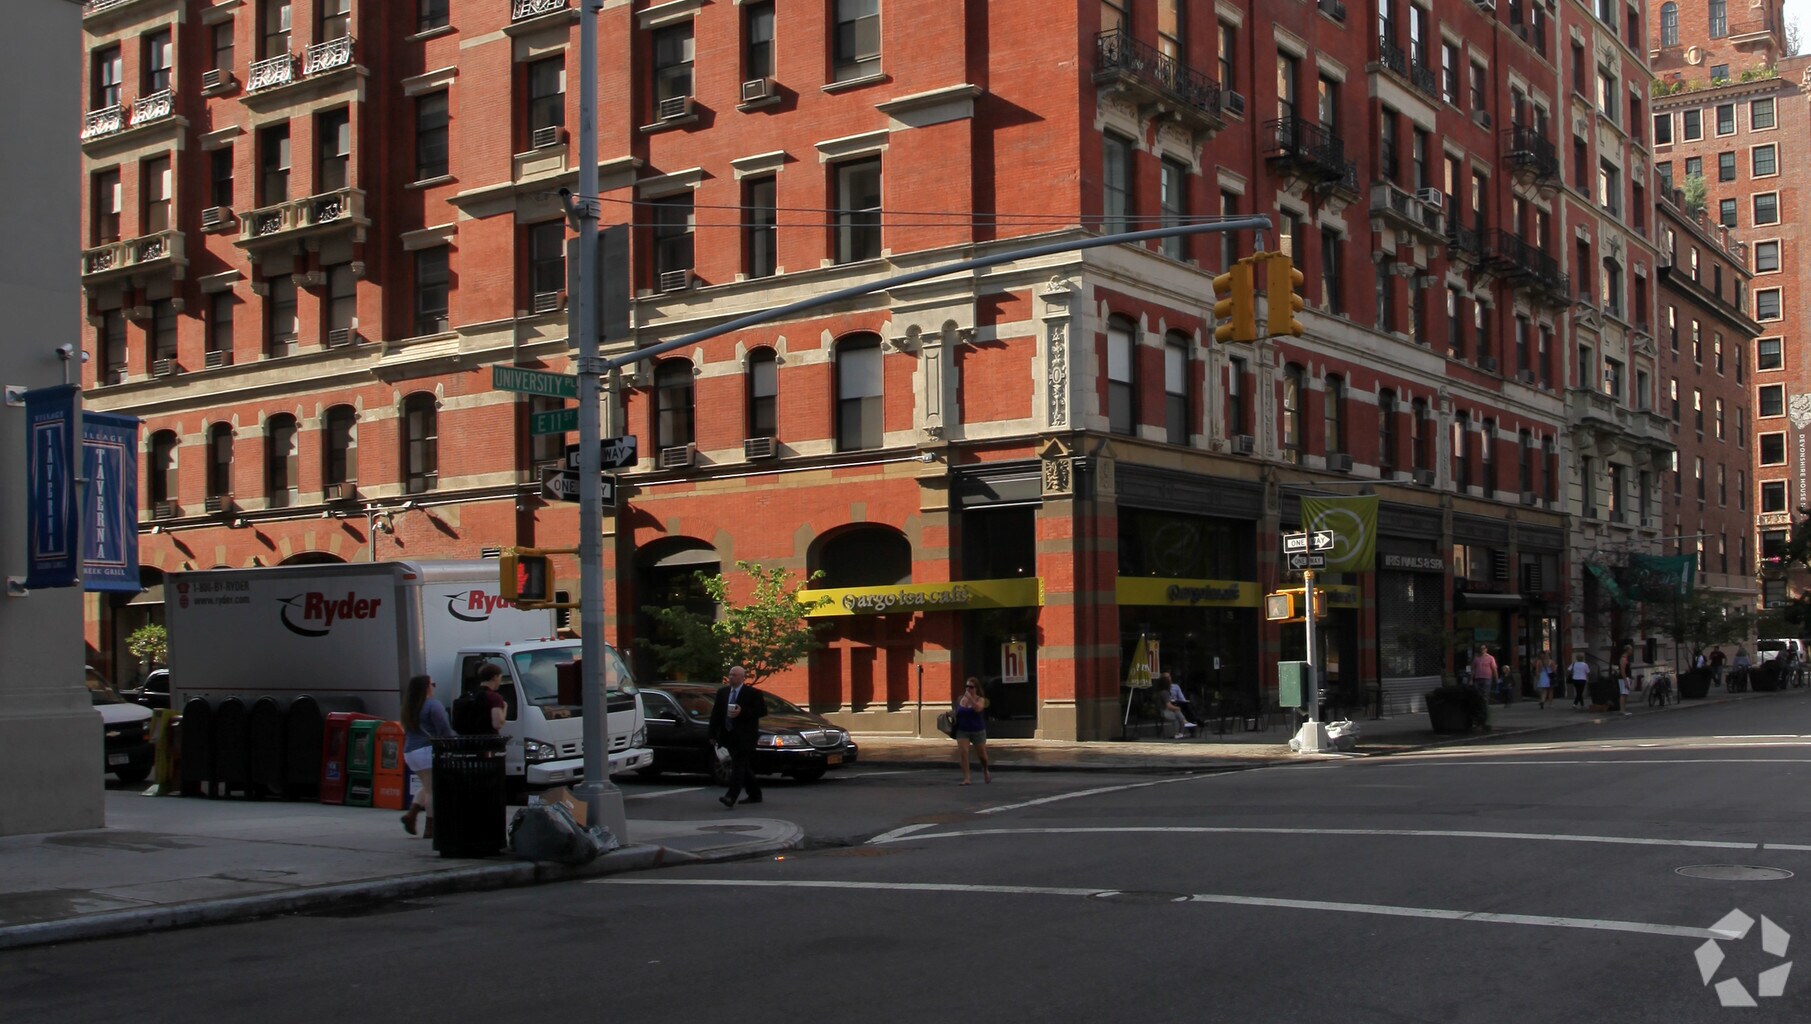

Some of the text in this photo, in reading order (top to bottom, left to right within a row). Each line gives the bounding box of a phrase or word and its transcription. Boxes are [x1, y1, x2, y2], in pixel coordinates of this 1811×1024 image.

[495, 368, 575, 394] UNIVERSITY PL
[538, 412, 573, 432] E 11 ST
[84, 432, 123, 443] ILLAGE
[604, 447, 625, 461] WAY
[46, 429, 55, 552] TAVERNA
[554, 479, 576, 493] ONE
[96, 448, 106, 559] TAVERNA
[1291, 538, 1305, 547] ONE
[1385, 555, 1400, 566] IRIS
[1401, 556, 1424, 568] NAILS
[1430, 558, 1444, 569] SPA
[104, 568, 125, 576] GRILL
[304, 591, 381, 626] Ryder
[857, 594, 896, 611] argo
[899, 590, 925, 605] tea
